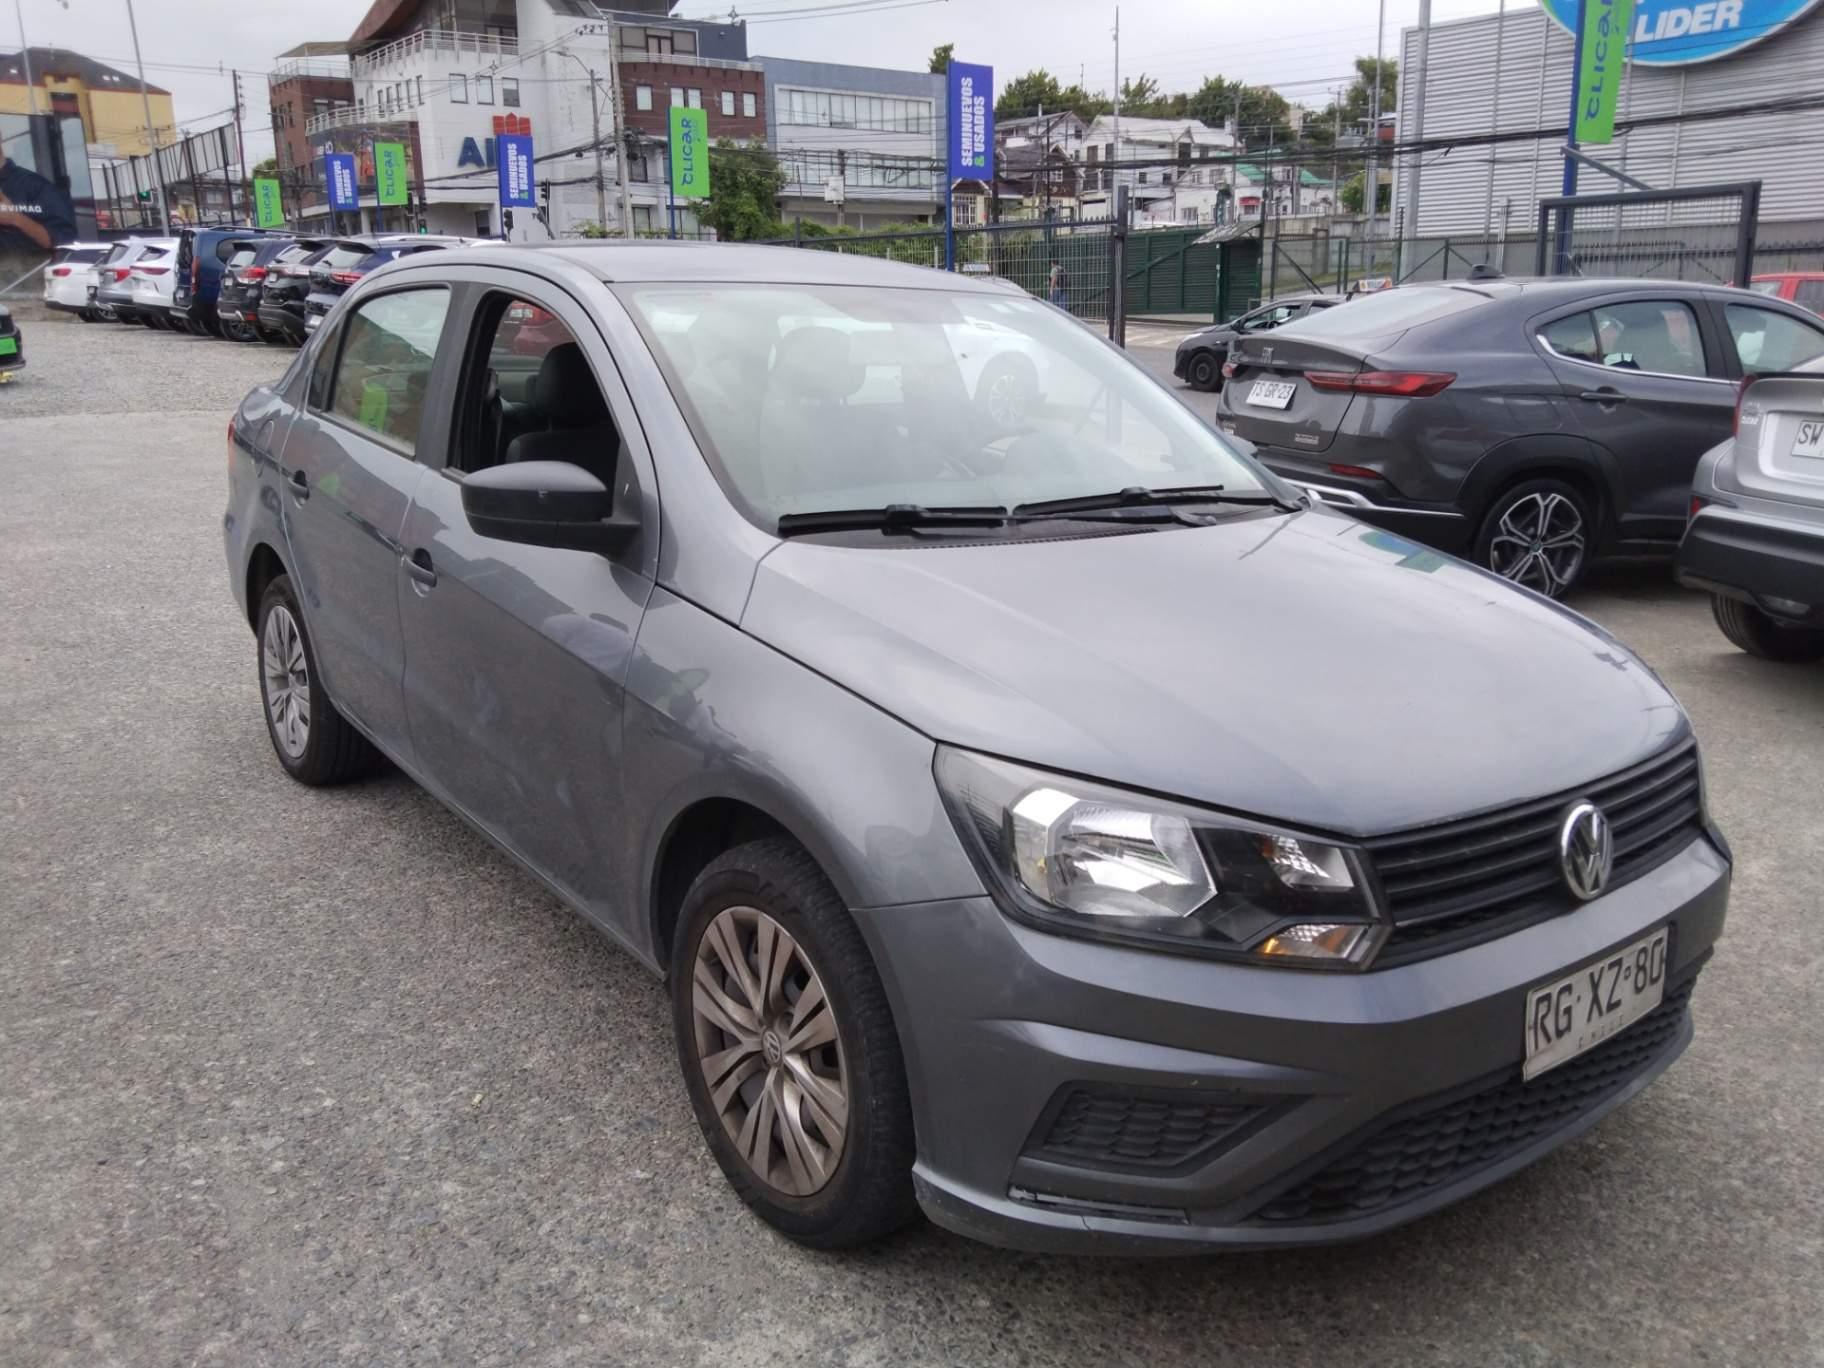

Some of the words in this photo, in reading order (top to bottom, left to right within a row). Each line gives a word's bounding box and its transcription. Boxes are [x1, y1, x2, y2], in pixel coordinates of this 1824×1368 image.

[1634, 0, 1744, 42] LIDER
[961, 77, 973, 167] SEMINUEVOS
[974, 96, 985, 153] USADOS
[507, 143, 519, 199] SEMINUEVOS
[518, 155, 528, 190] USADOS
[974, 155, 985, 167] &
